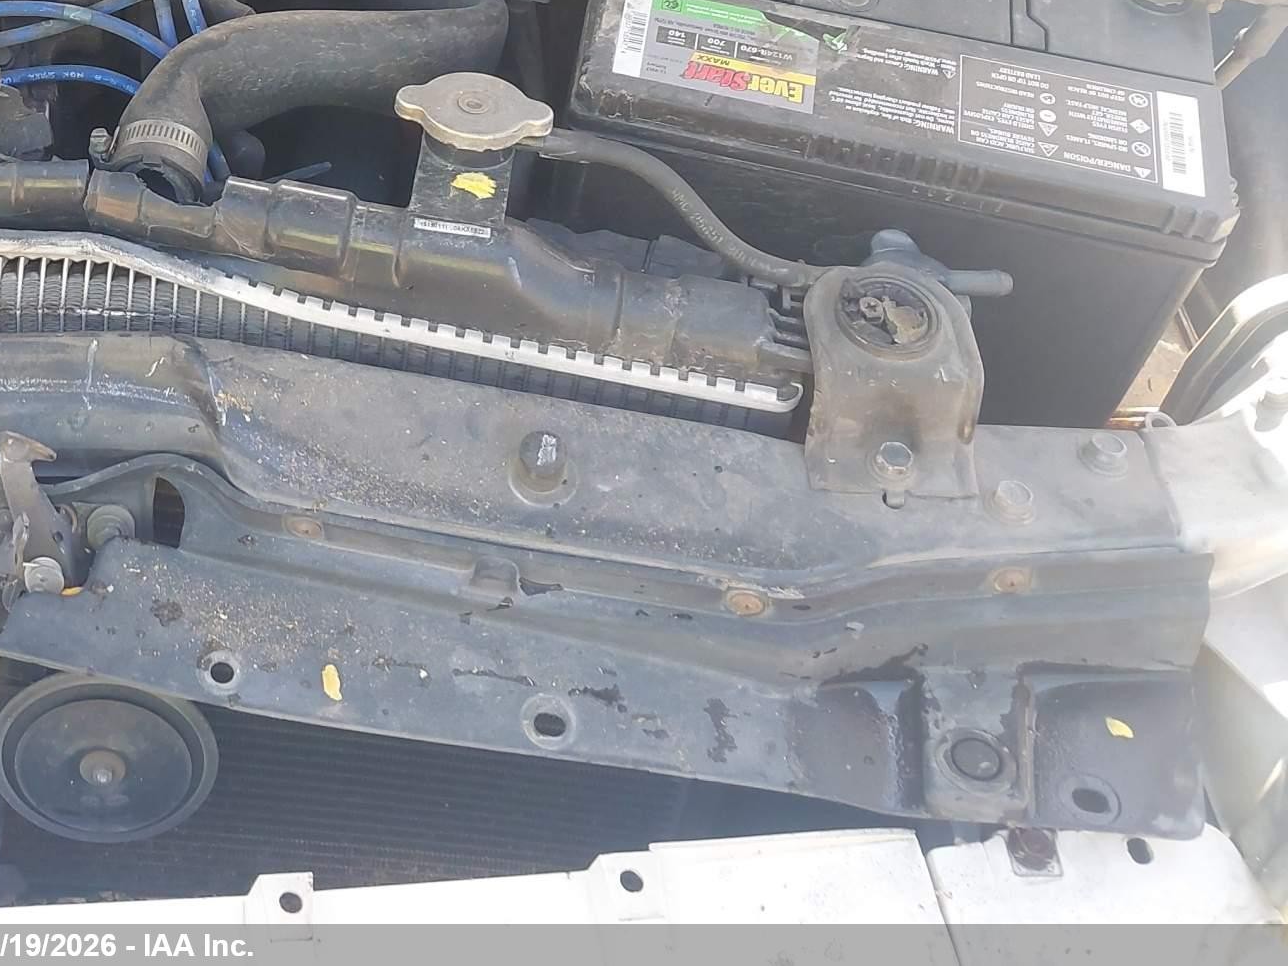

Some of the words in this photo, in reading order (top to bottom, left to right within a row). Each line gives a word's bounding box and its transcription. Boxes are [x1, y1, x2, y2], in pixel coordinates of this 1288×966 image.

[668, 29, 685, 37] 140
[707, 37, 725, 46] 700
[696, 53, 729, 66] MAXX
[682, 61, 804, 103] EverStart
[913, 119, 954, 133] WARNING:
[1063, 152, 1130, 171] DANGER/POISON
